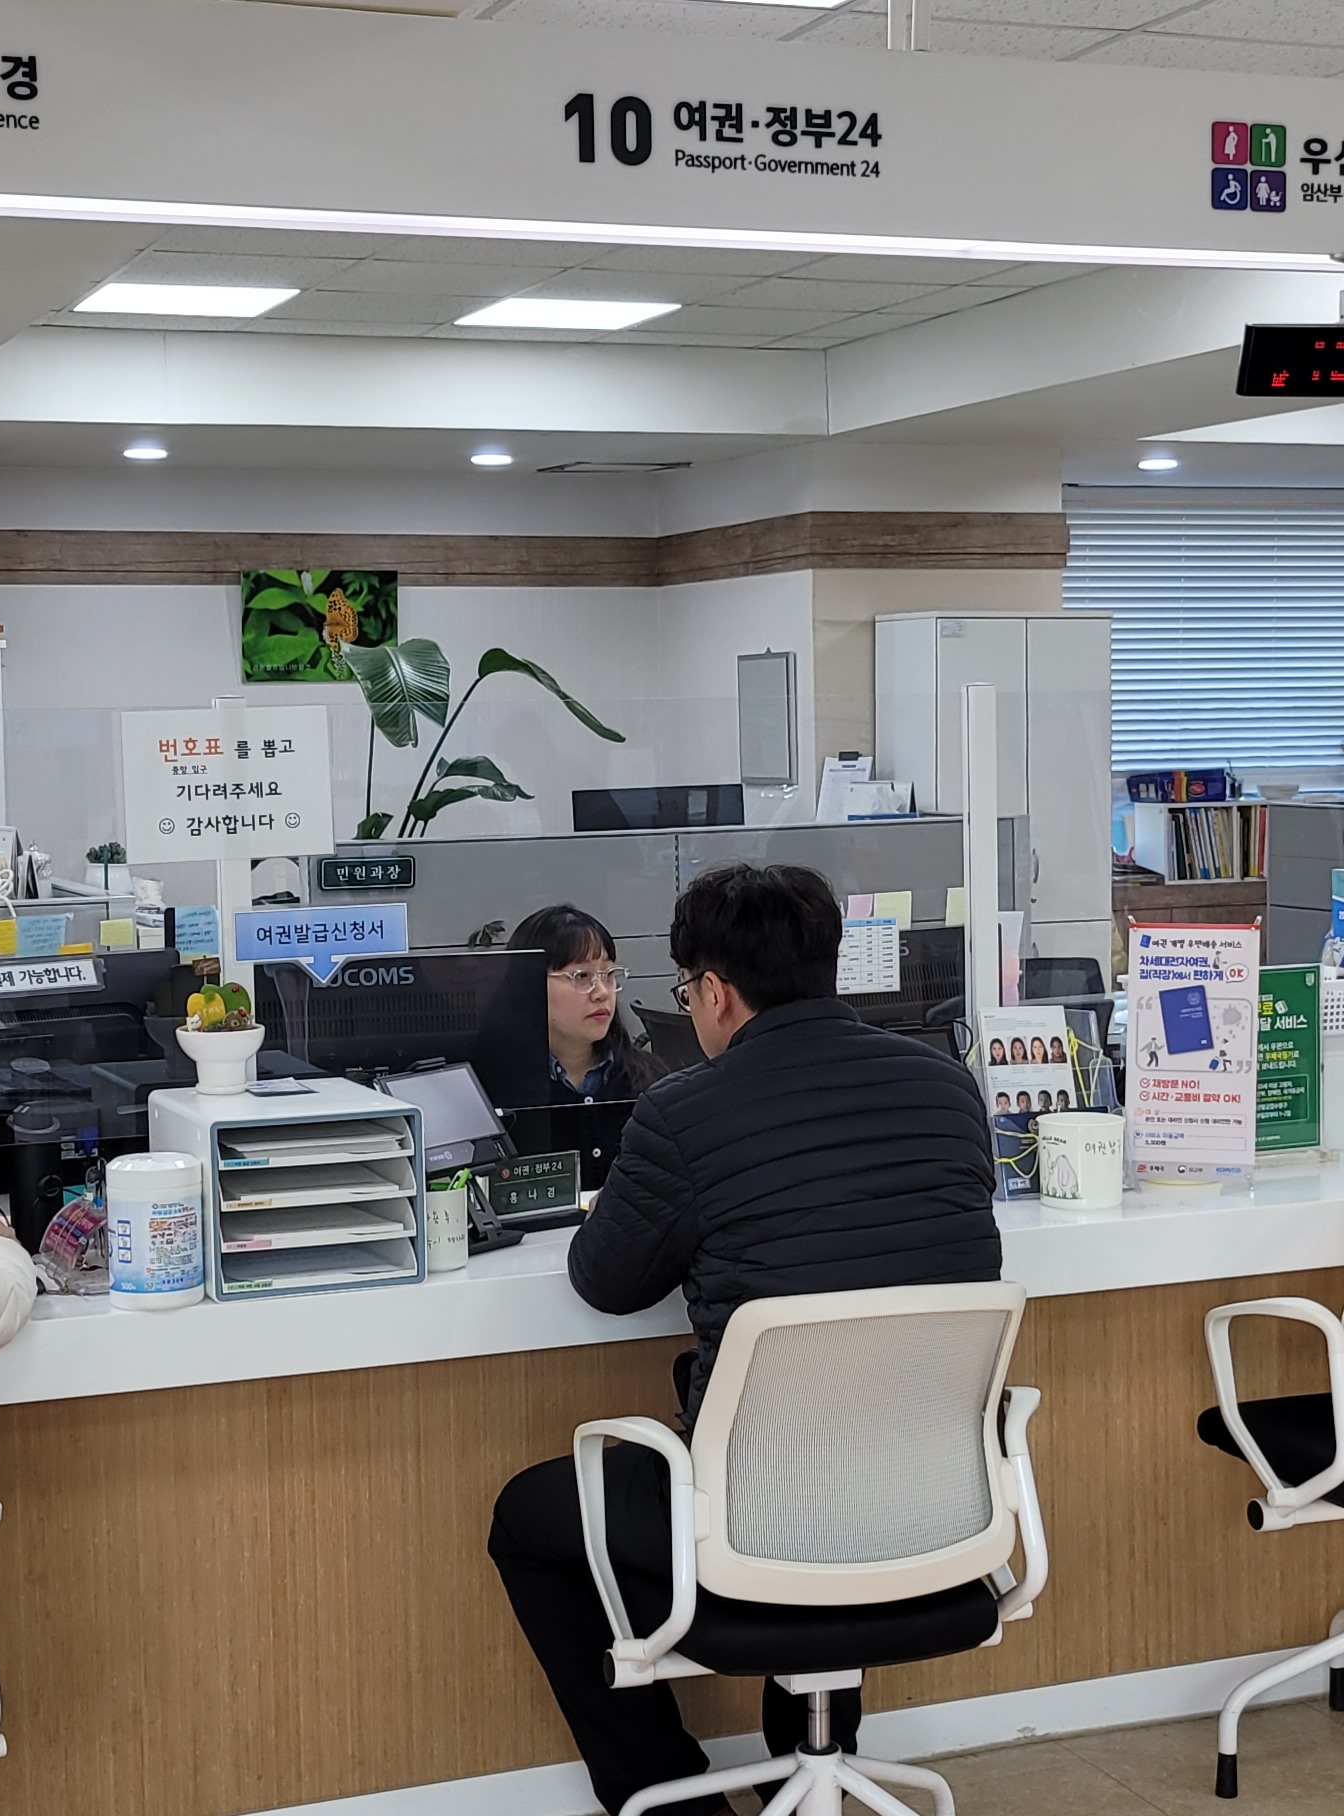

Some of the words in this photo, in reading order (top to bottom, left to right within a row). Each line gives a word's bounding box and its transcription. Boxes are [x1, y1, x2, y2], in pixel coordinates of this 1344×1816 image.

[564, 93, 653, 166] 10
[673, 100, 883, 148] 여권·정부24
[860, 161, 881, 178] 24
[158, 737, 224, 763] 번호표
[234, 740, 252, 759] 를
[261, 739, 296, 758] 뽑고
[176, 781, 283, 801] 기다려주세요
[186, 813, 275, 836] 감사합니다
[336, 864, 402, 882] 민원과장
[256, 919, 385, 945] 여권발급신청서
[1219, 940, 1243, 949] 서비스
[19, 966, 87, 985] 가능합니다.
[1193, 970, 1224, 981] 편하게
[1229, 969, 1244, 979] OK
[1274, 1014, 1308, 1030] 서비스
